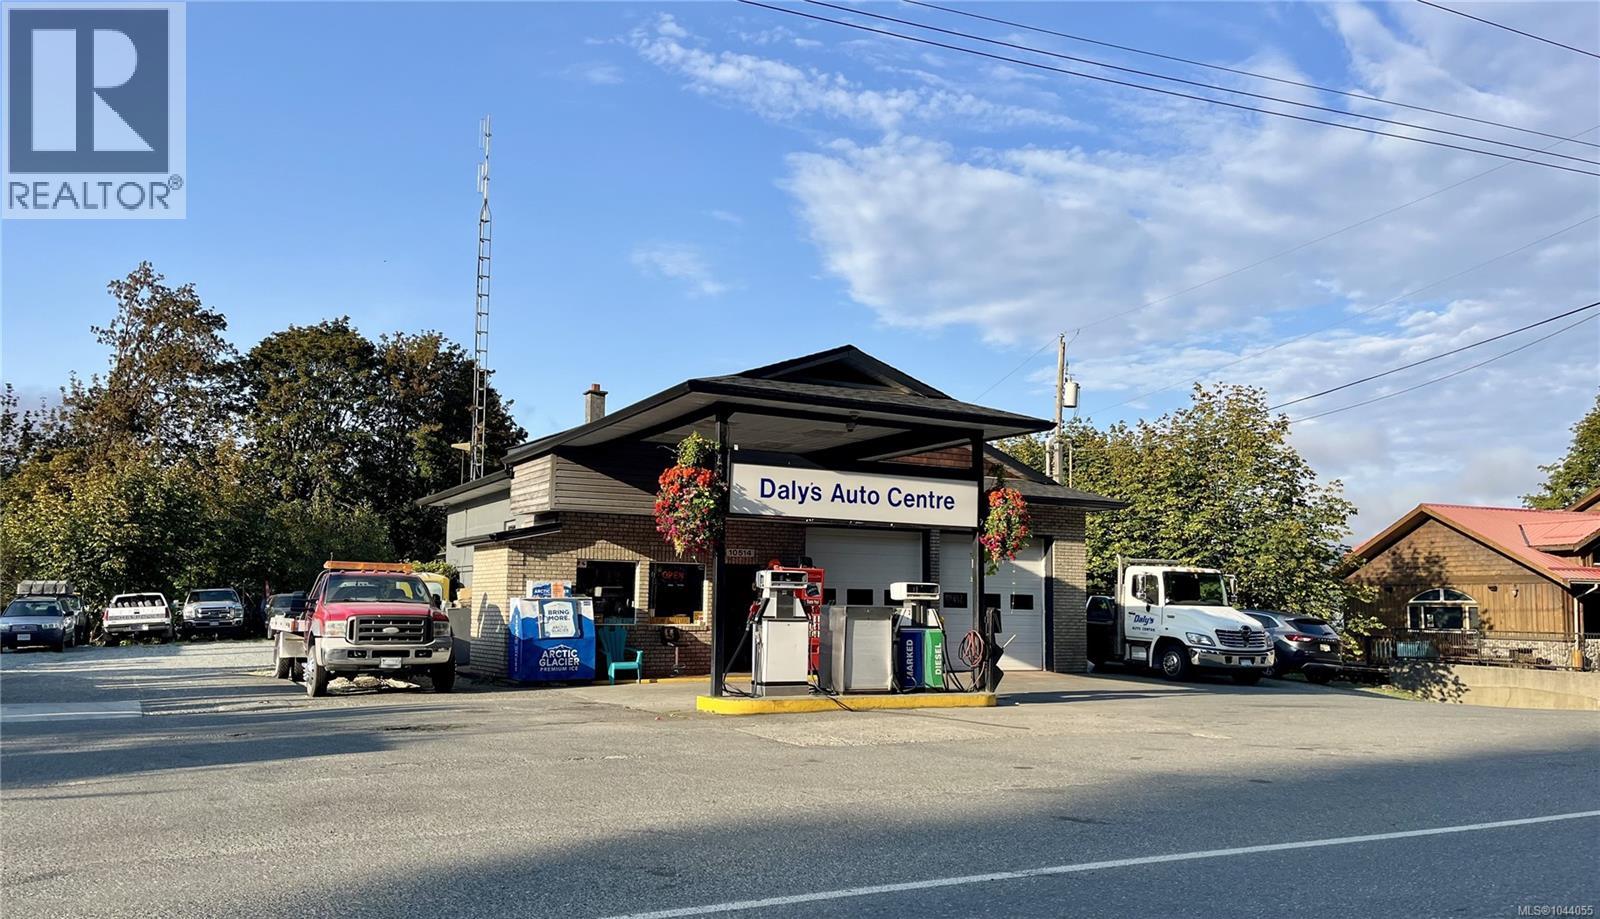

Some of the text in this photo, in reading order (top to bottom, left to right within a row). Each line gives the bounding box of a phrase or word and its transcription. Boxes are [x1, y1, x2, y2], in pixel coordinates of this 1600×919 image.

[760, 478, 955, 510] Daly's Auto Centre
[661, 570, 684, 579] OPEN
[1133, 614, 1155, 626] Daly's
[541, 649, 578, 659] ARCTIC
[934, 642, 943, 676] DIESEL
[538, 657, 580, 667] GLACIER
